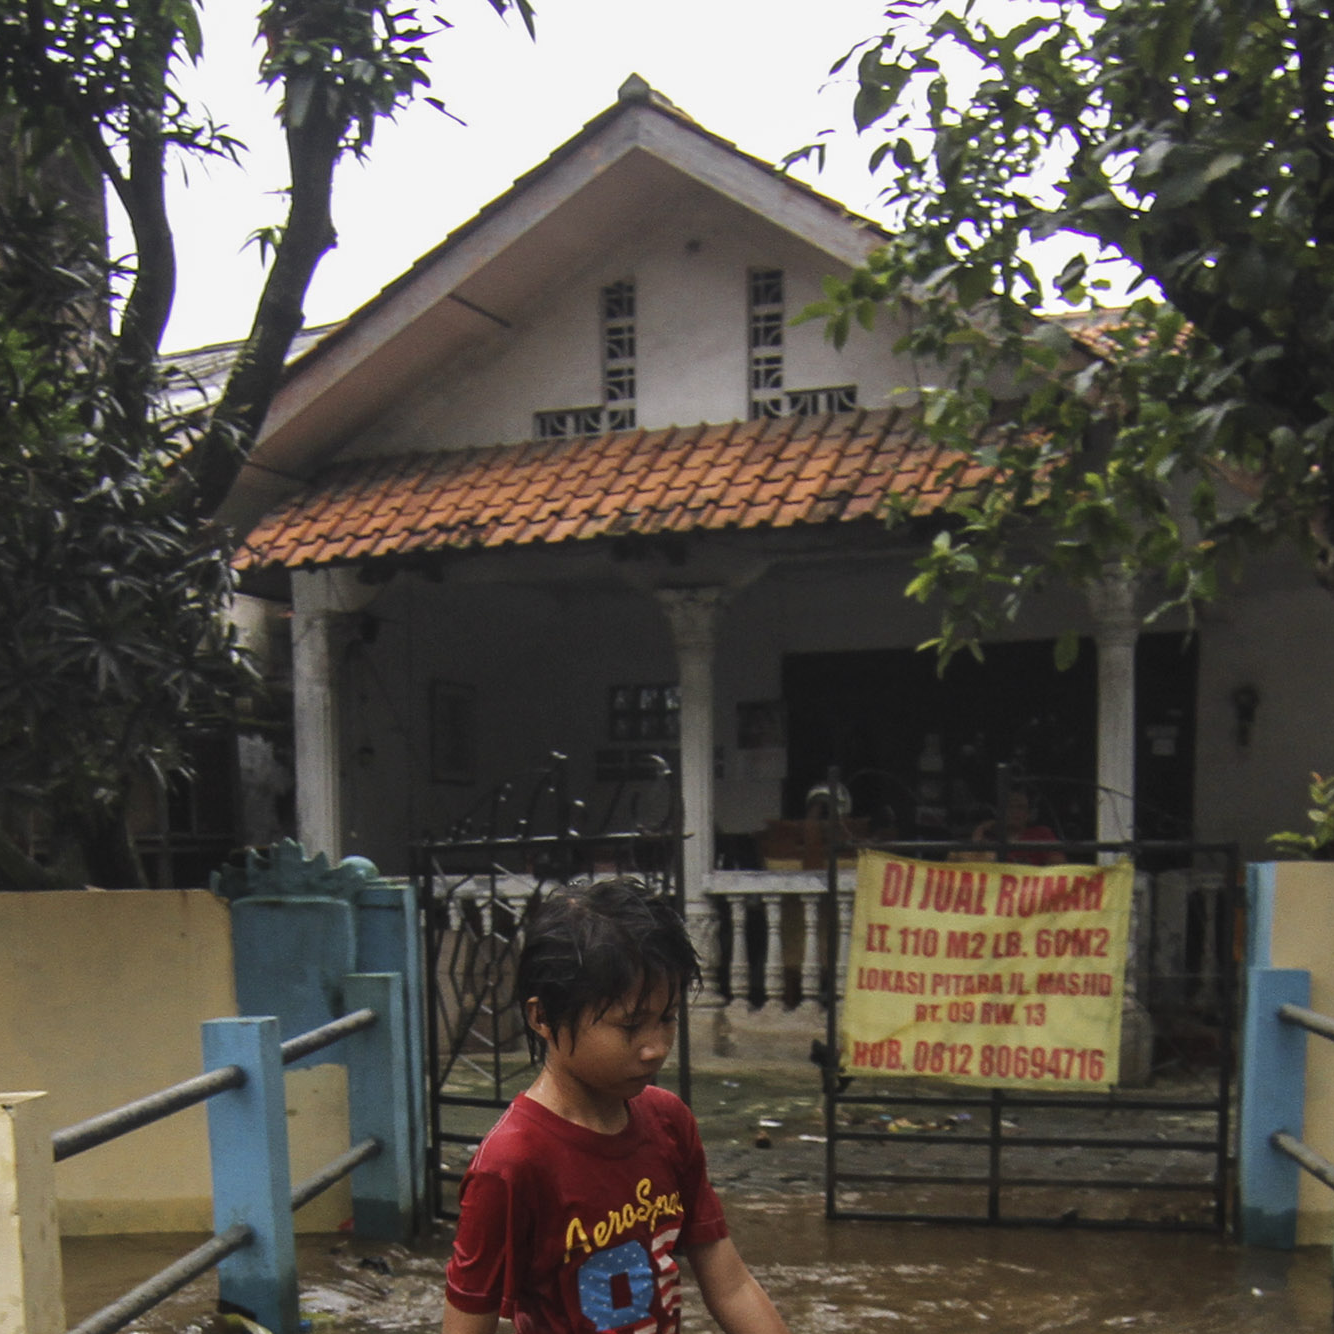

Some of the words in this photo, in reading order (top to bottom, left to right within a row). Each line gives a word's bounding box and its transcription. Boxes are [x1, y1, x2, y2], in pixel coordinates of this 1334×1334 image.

[881, 862, 915, 908] DI
[919, 867, 987, 916] JUAL
[995, 873, 1105, 918] RUMAH
[866, 923, 891, 953] LT.
[899, 927, 939, 957] 110
[946, 930, 986, 959] M2
[992, 930, 1028, 958] LB.
[1035, 928, 1110, 958] 60M2
[857, 967, 925, 995] LOKASI
[931, 973, 1003, 996] PITARA
[1008, 973, 1030, 995] JL.
[1036, 972, 1113, 996] MASJID
[915, 1004, 942, 1022] RT.
[948, 1001, 975, 1024] 09
[1024, 1003, 1047, 1026] 13
[852, 1039, 907, 1070] HUB.
[913, 1041, 974, 1075] 0812
[979, 1045, 1105, 1081] 80694716
